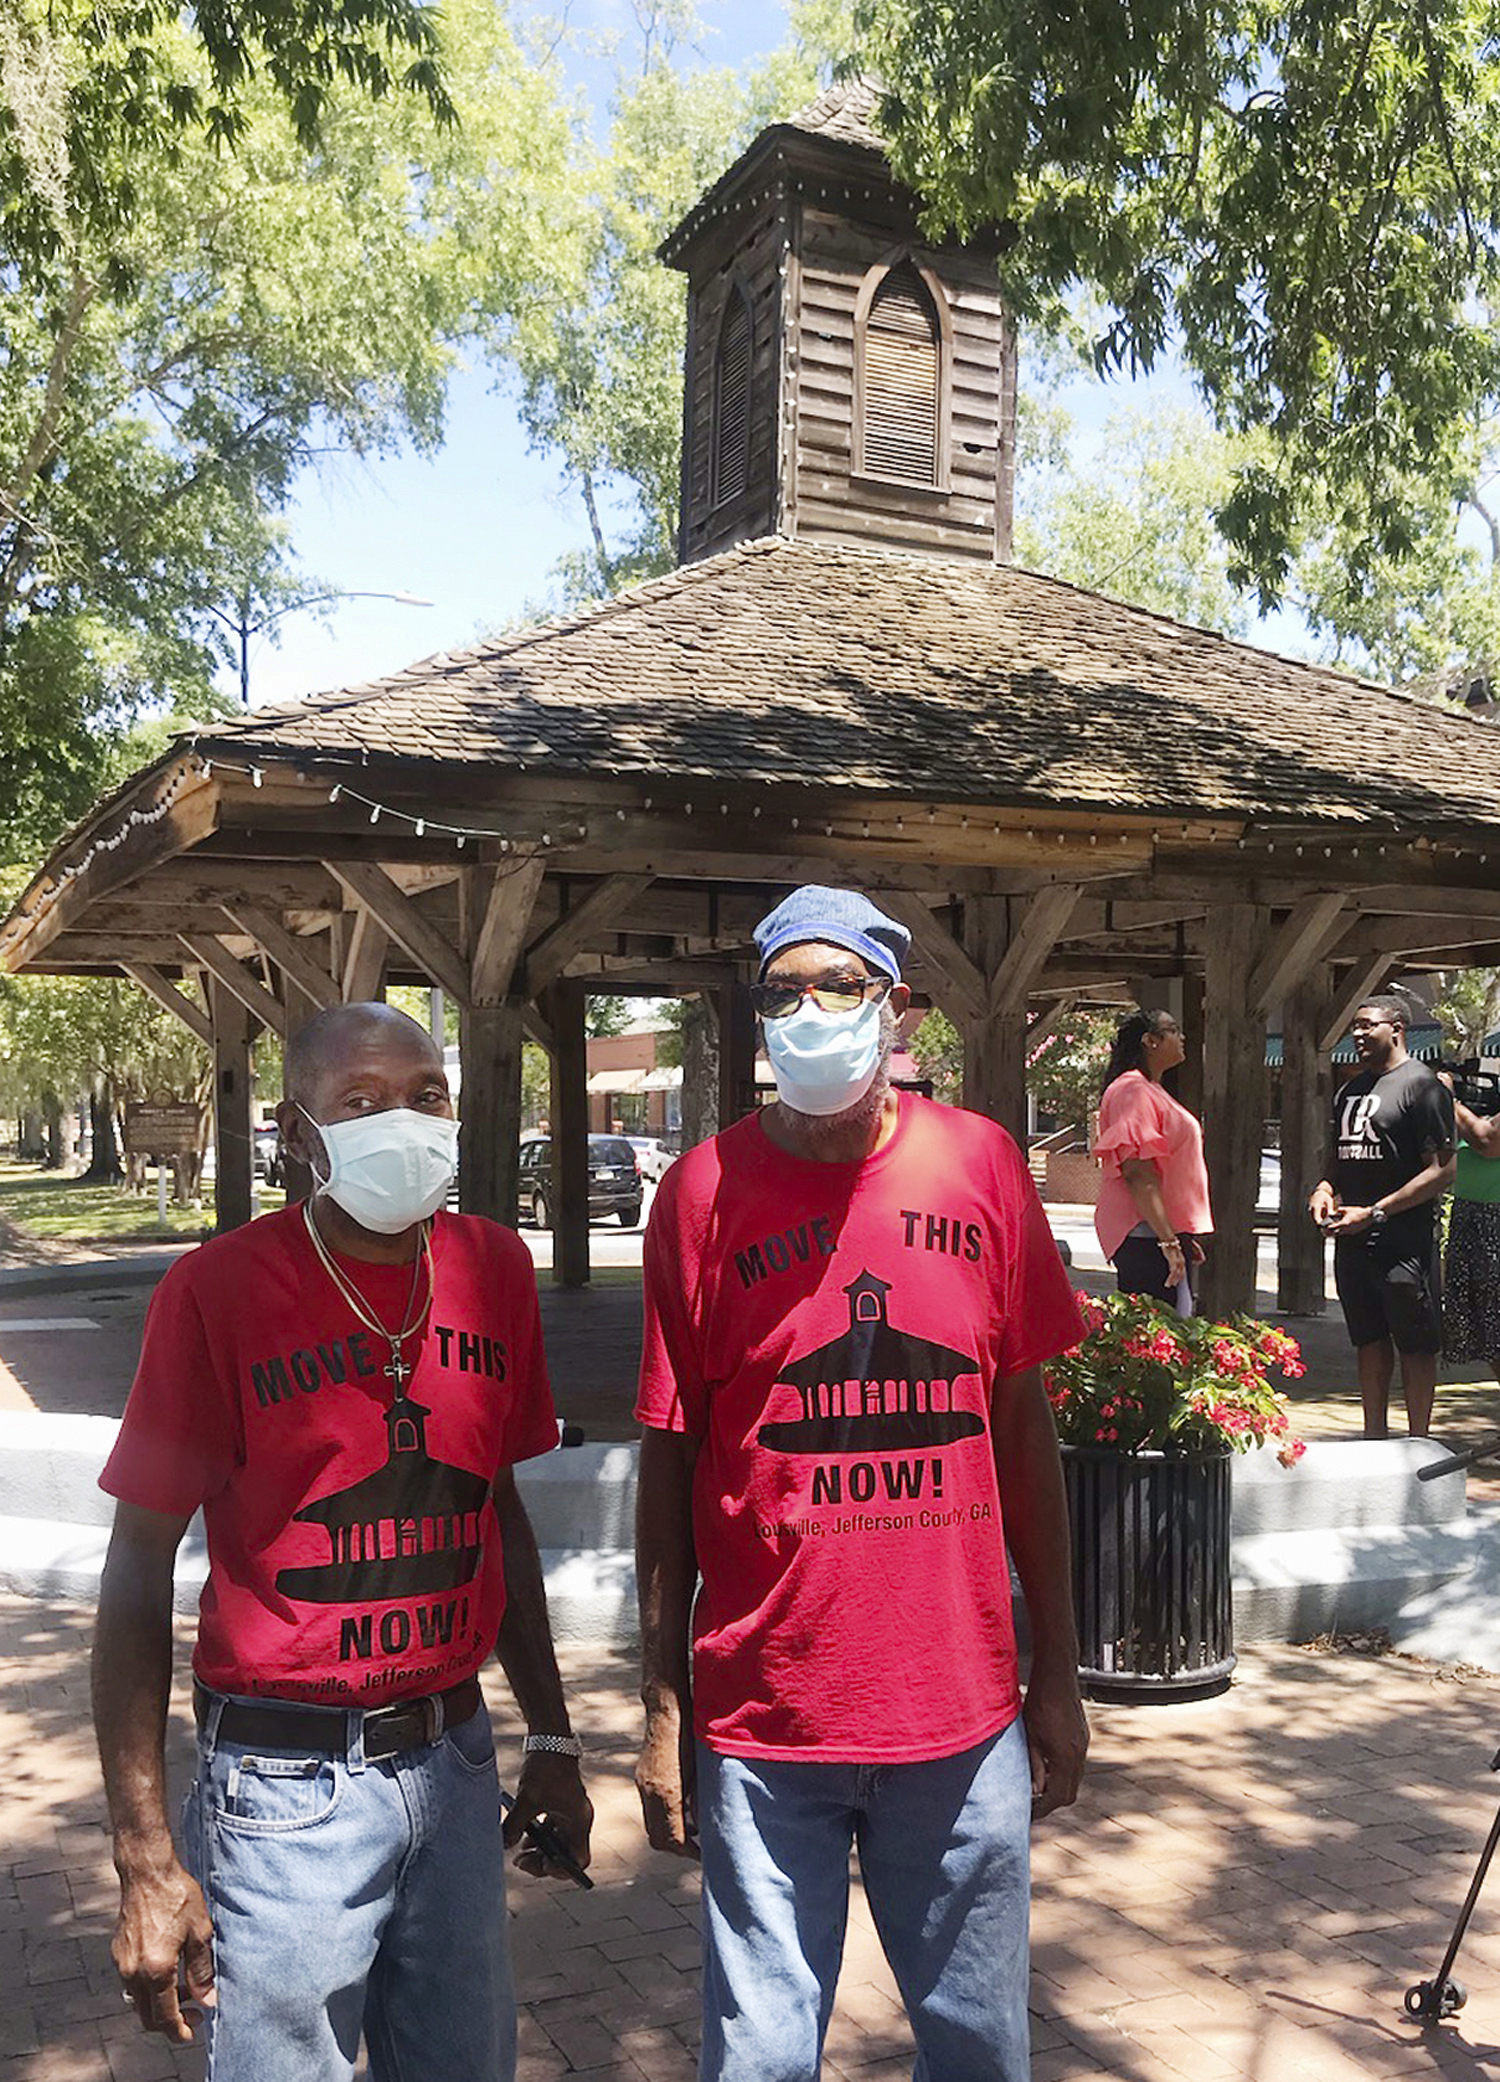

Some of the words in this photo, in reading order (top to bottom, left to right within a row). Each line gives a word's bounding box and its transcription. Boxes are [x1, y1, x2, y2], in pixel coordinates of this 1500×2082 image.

[1339, 1094, 1381, 1143] LR
[734, 1216, 837, 1290] MOVE
[900, 1210, 982, 1262] THIS
[251, 1333, 375, 1407] MOVE
[435, 1327, 508, 1383] THIS
[812, 1459, 944, 1506] NOW!
[754, 1518, 825, 1538] Lousville,
[832, 1514, 913, 1534] Jefferson
[919, 1508, 965, 1528] Couty,
[970, 1503, 991, 1520] GA
[340, 1597, 469, 1661] NOW!
